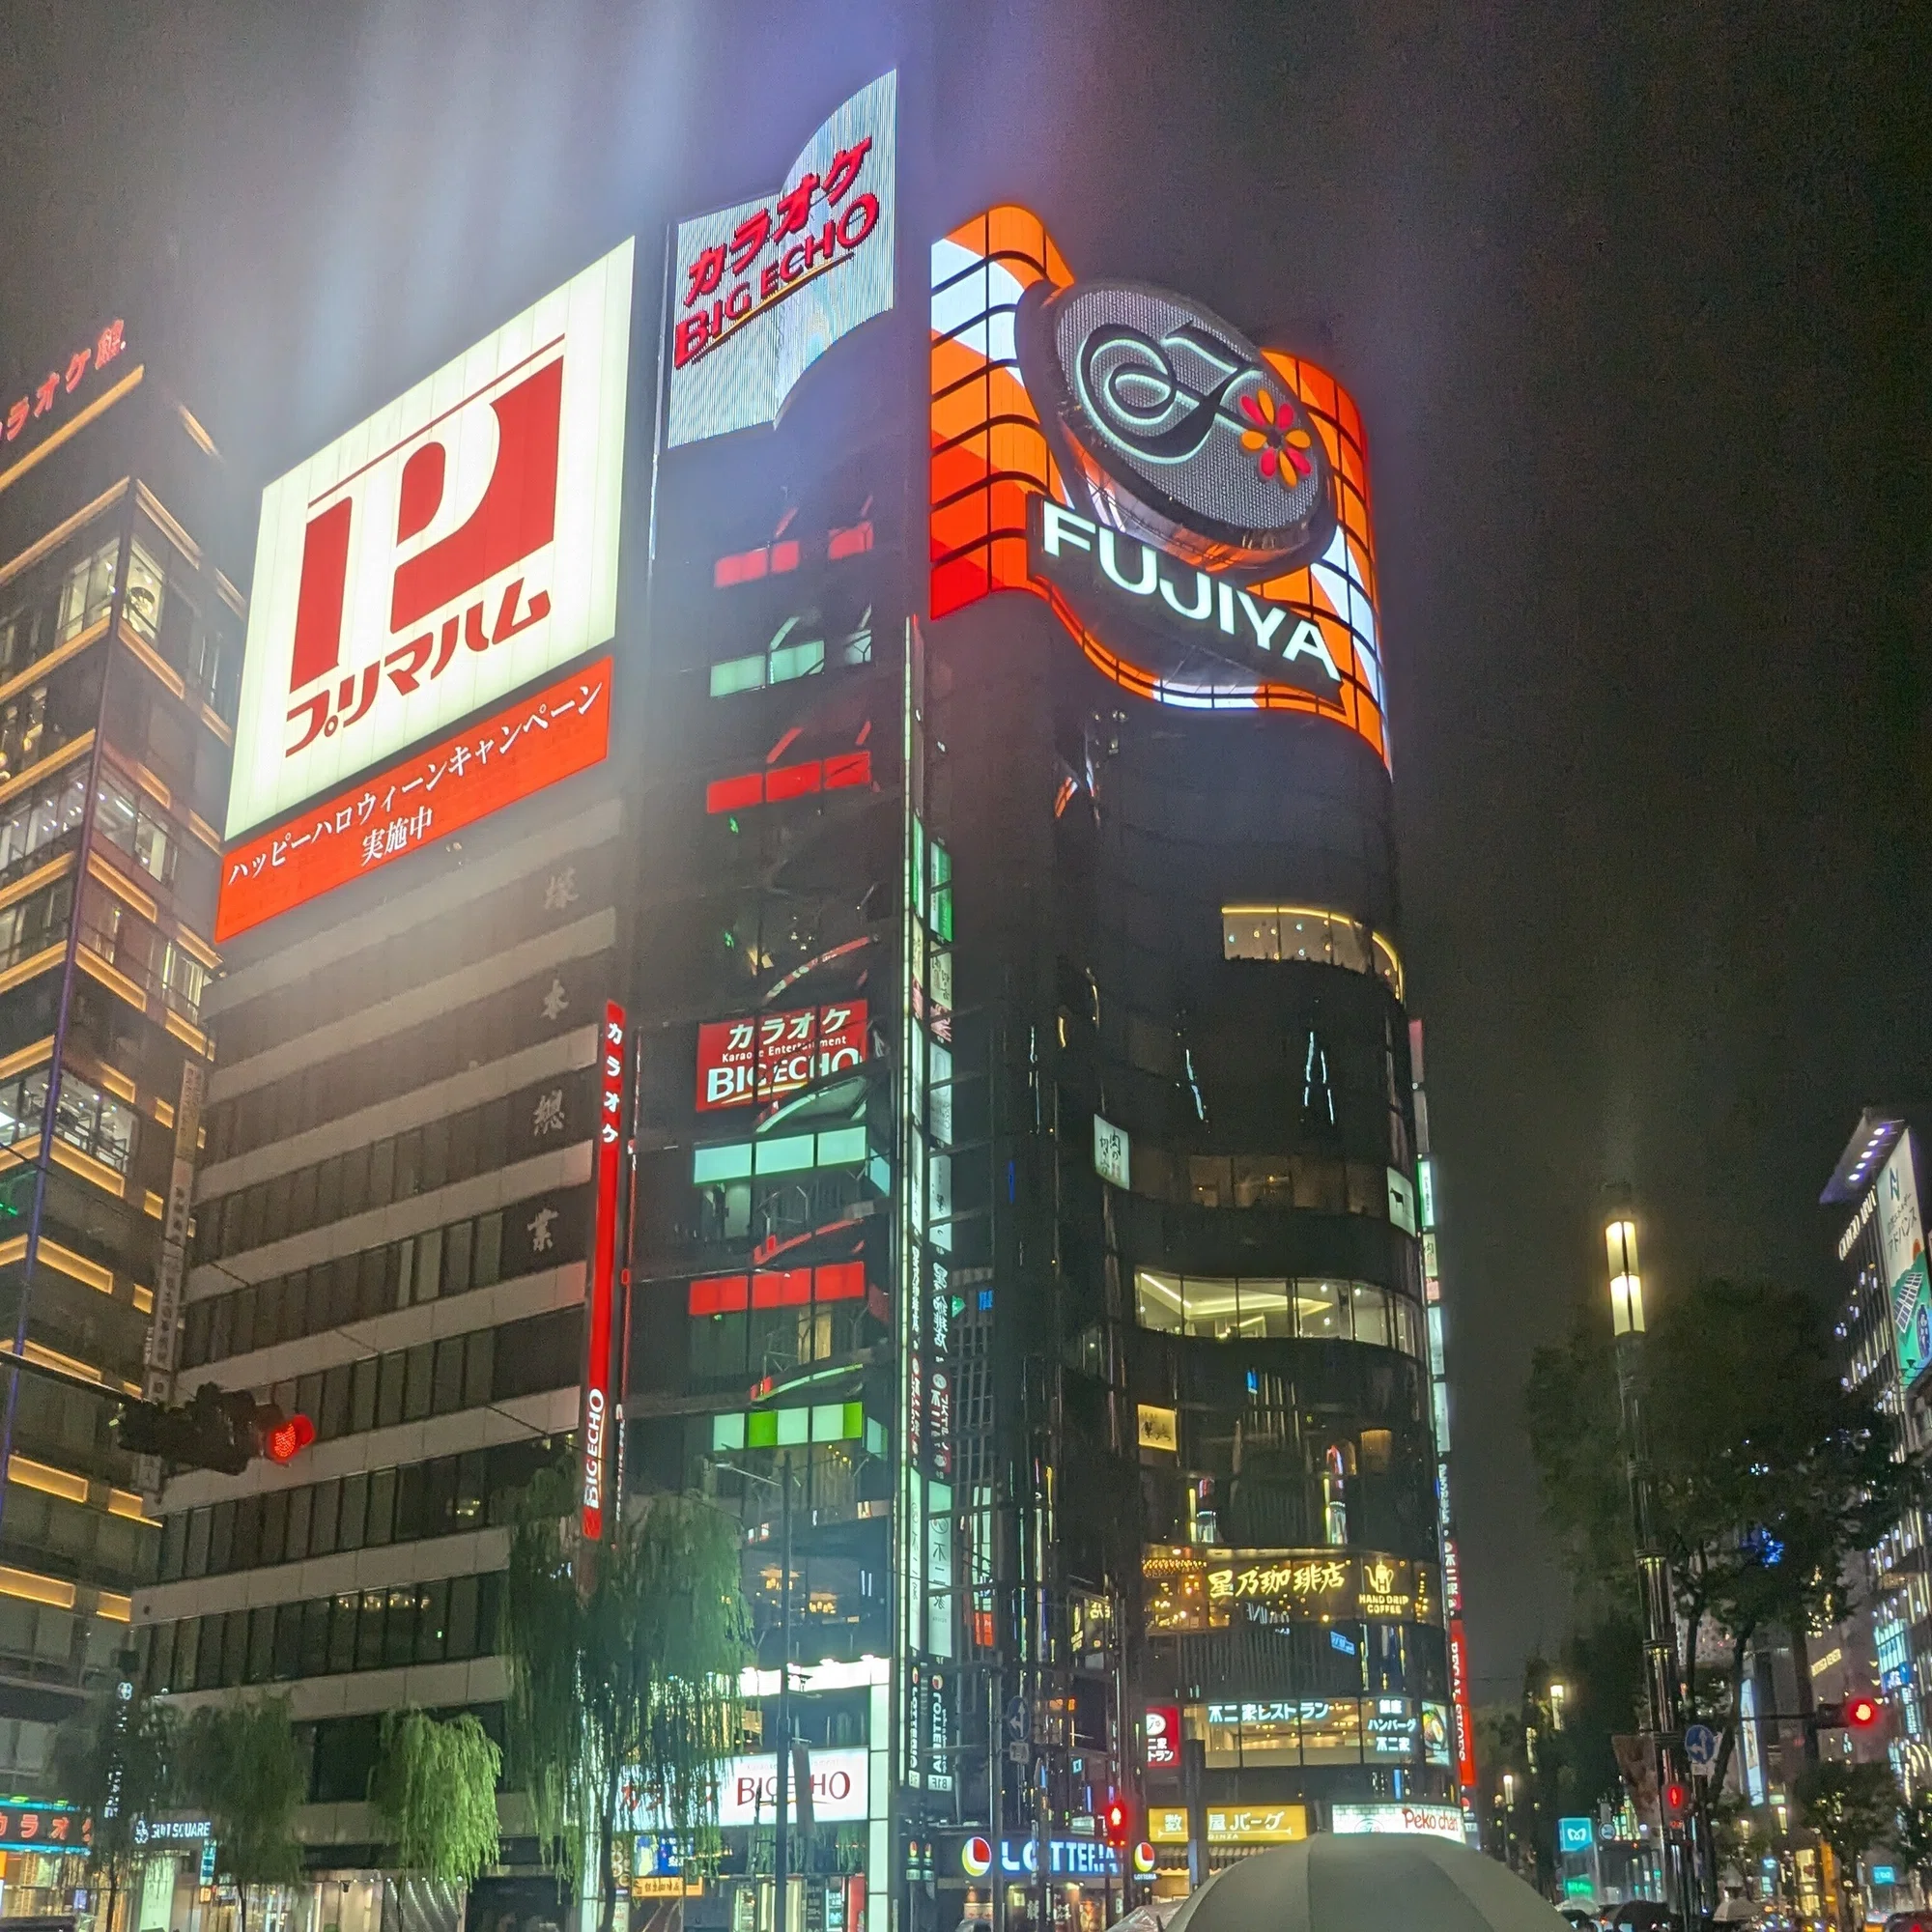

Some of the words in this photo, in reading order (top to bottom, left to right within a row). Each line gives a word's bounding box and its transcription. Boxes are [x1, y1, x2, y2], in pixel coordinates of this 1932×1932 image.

[683, 137, 872, 306] カラオケ
[676, 288, 753, 369] BIG
[760, 194, 879, 301] ECHO
[0, 319, 125, 441] ラオケ館
[1042, 501, 1342, 682] FUJIYA
[286, 577, 552, 758] プリマハム
[228, 682, 604, 887] ハッピーハロウィーンキャンペーン
[361, 808, 434, 867] 実施中
[727, 1009, 851, 1050] カラオケ
[707, 1063, 767, 1103] BIG
[774, 1048, 863, 1083] ECHO
[723, 1049, 764, 1064] Karaoe
[603, 1022, 623, 1144] カラオケ
[587, 1388, 605, 1456] ECHO
[583, 1457, 600, 1509] BIG
[1208, 1561, 1346, 1599] 星乃珈琲店
[1359, 1594, 1384, 1604] HAND
[1385, 1595, 1409, 1605] DRIP
[1367, 1604, 1402, 1614] COFFEE
[1208, 1702, 1329, 1723] 不二家レストラン
[1368, 1719, 1416, 1732] ハンバーグ
[1376, 1736, 1410, 1751] 不二家
[785, 1771, 851, 1800] EHO
[1165, 1811, 1285, 1832] 数屋バーグ
[1402, 1807, 1436, 1829] Peko
